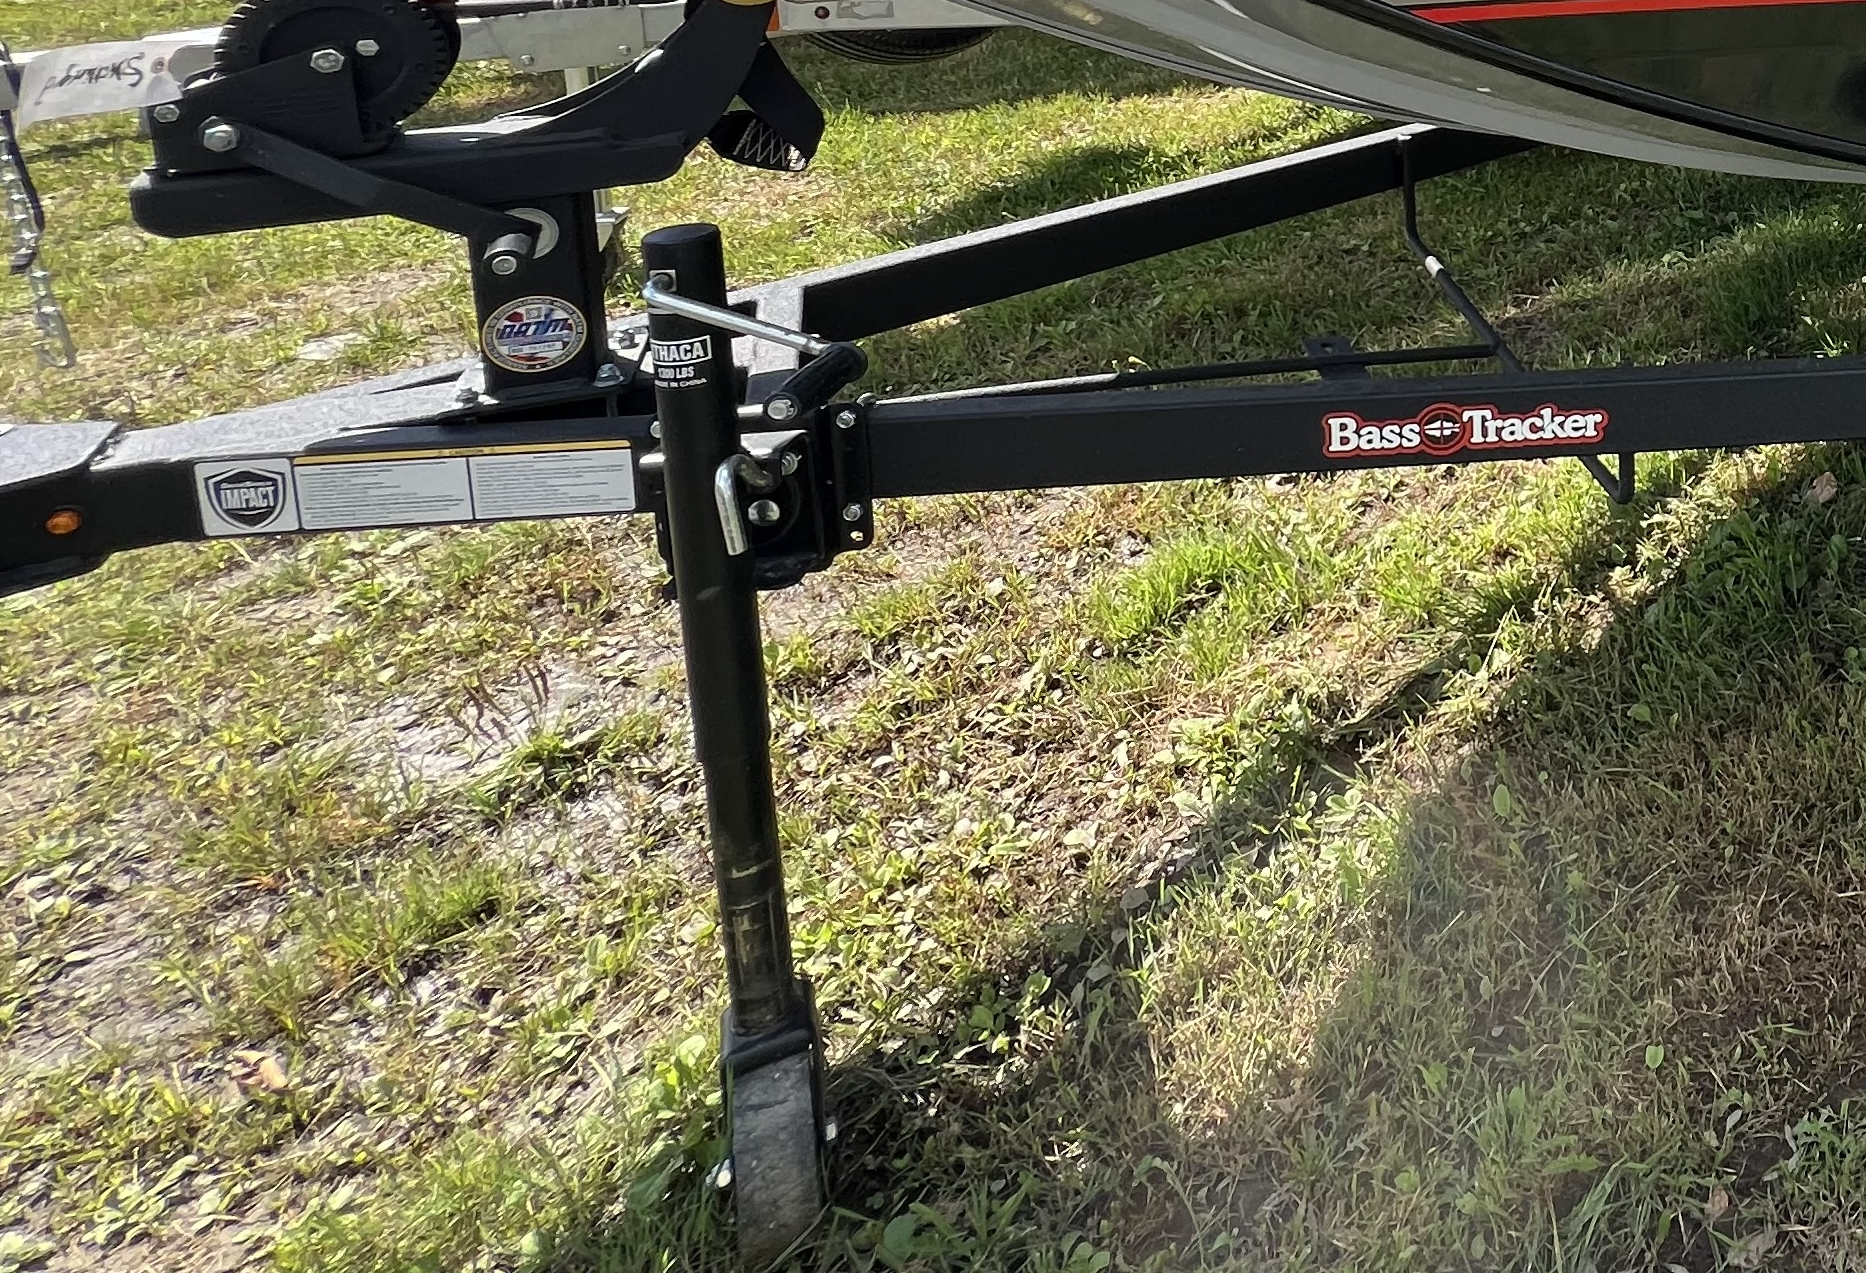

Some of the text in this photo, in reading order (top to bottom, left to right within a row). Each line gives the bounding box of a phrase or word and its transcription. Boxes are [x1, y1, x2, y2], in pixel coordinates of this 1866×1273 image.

[1328, 407, 1603, 452] Bass Tracker
[220, 487, 276, 510] IMPACT
